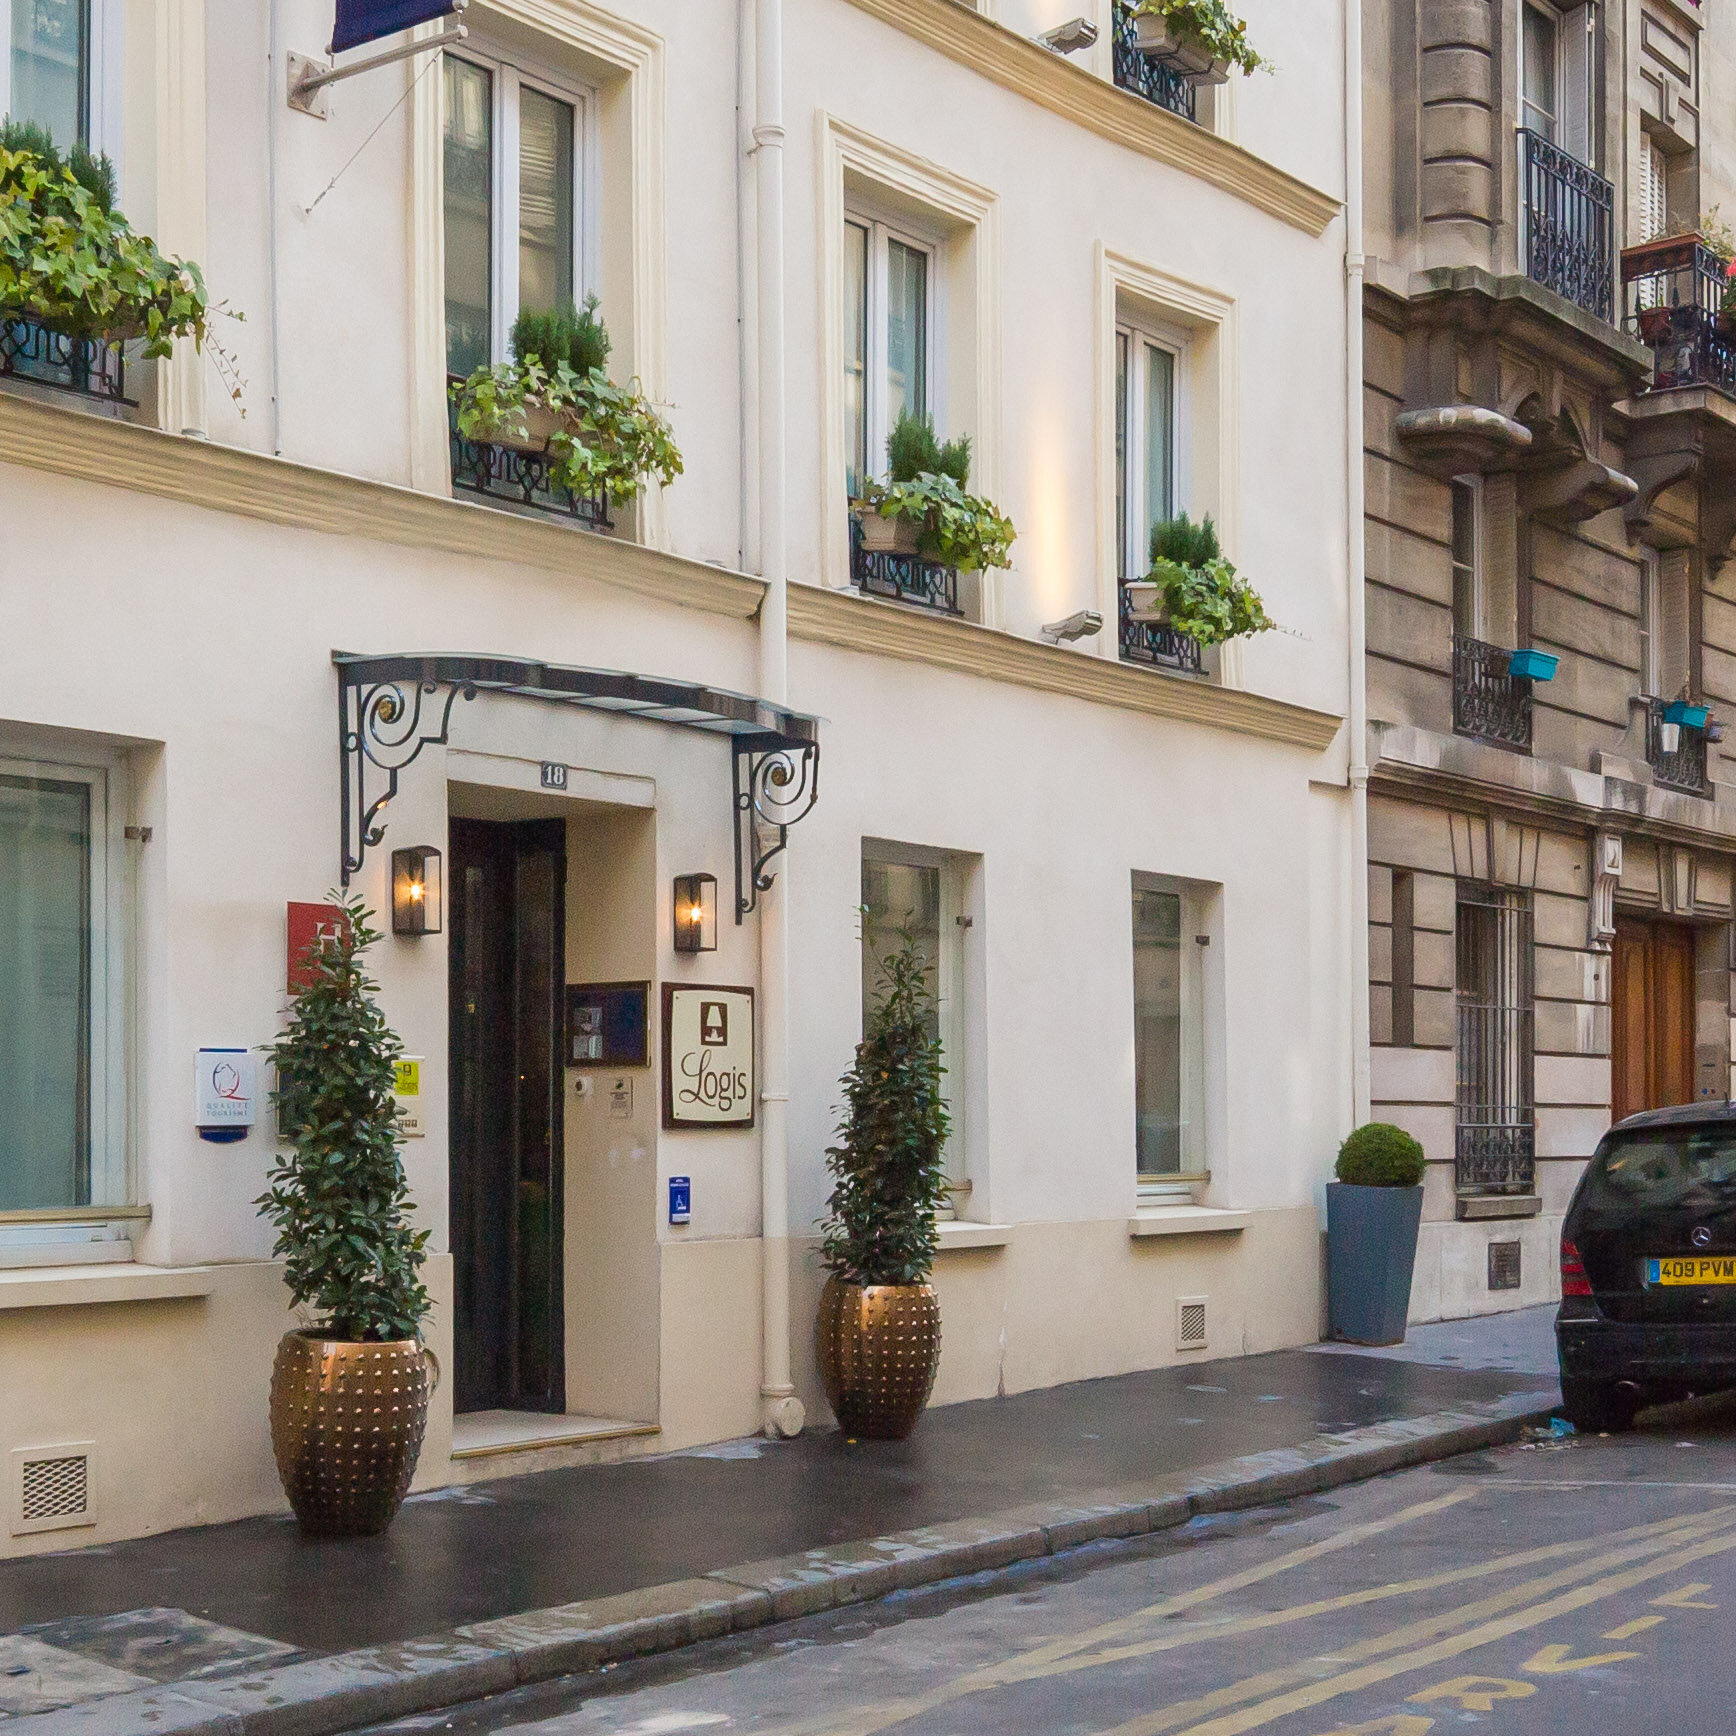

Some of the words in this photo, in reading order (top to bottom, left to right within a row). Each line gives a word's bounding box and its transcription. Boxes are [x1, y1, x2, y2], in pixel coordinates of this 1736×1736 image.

[546, 765, 564, 785] 18
[679, 1049, 748, 1112] Logis
[1661, 1261, 1695, 1278] 409
[1699, 1260, 1735, 1278] PVM
